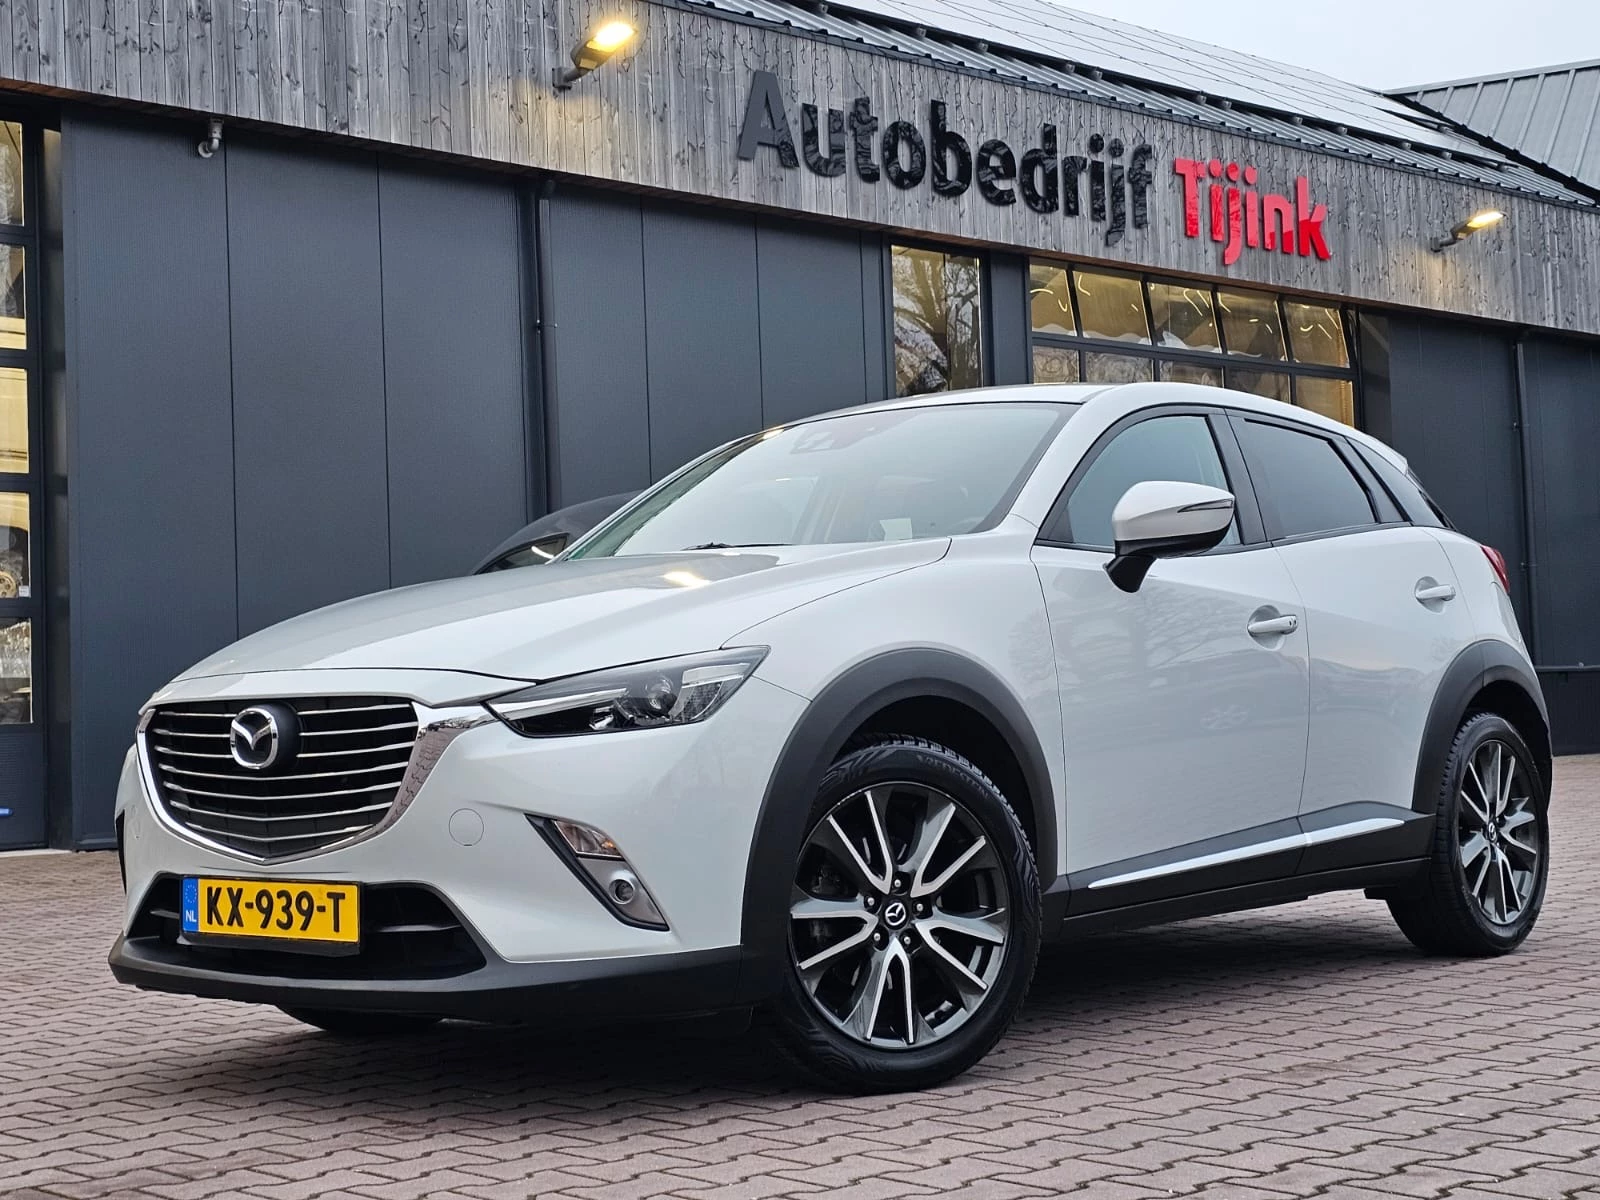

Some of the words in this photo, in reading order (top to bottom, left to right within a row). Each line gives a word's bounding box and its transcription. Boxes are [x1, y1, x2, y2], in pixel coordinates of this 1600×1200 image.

[738, 70, 1153, 246] Autobedrijf
[1175, 158, 1331, 264] Tijink
[185, 911, 197, 923] NL
[206, 886, 346, 932] KX-939-T
